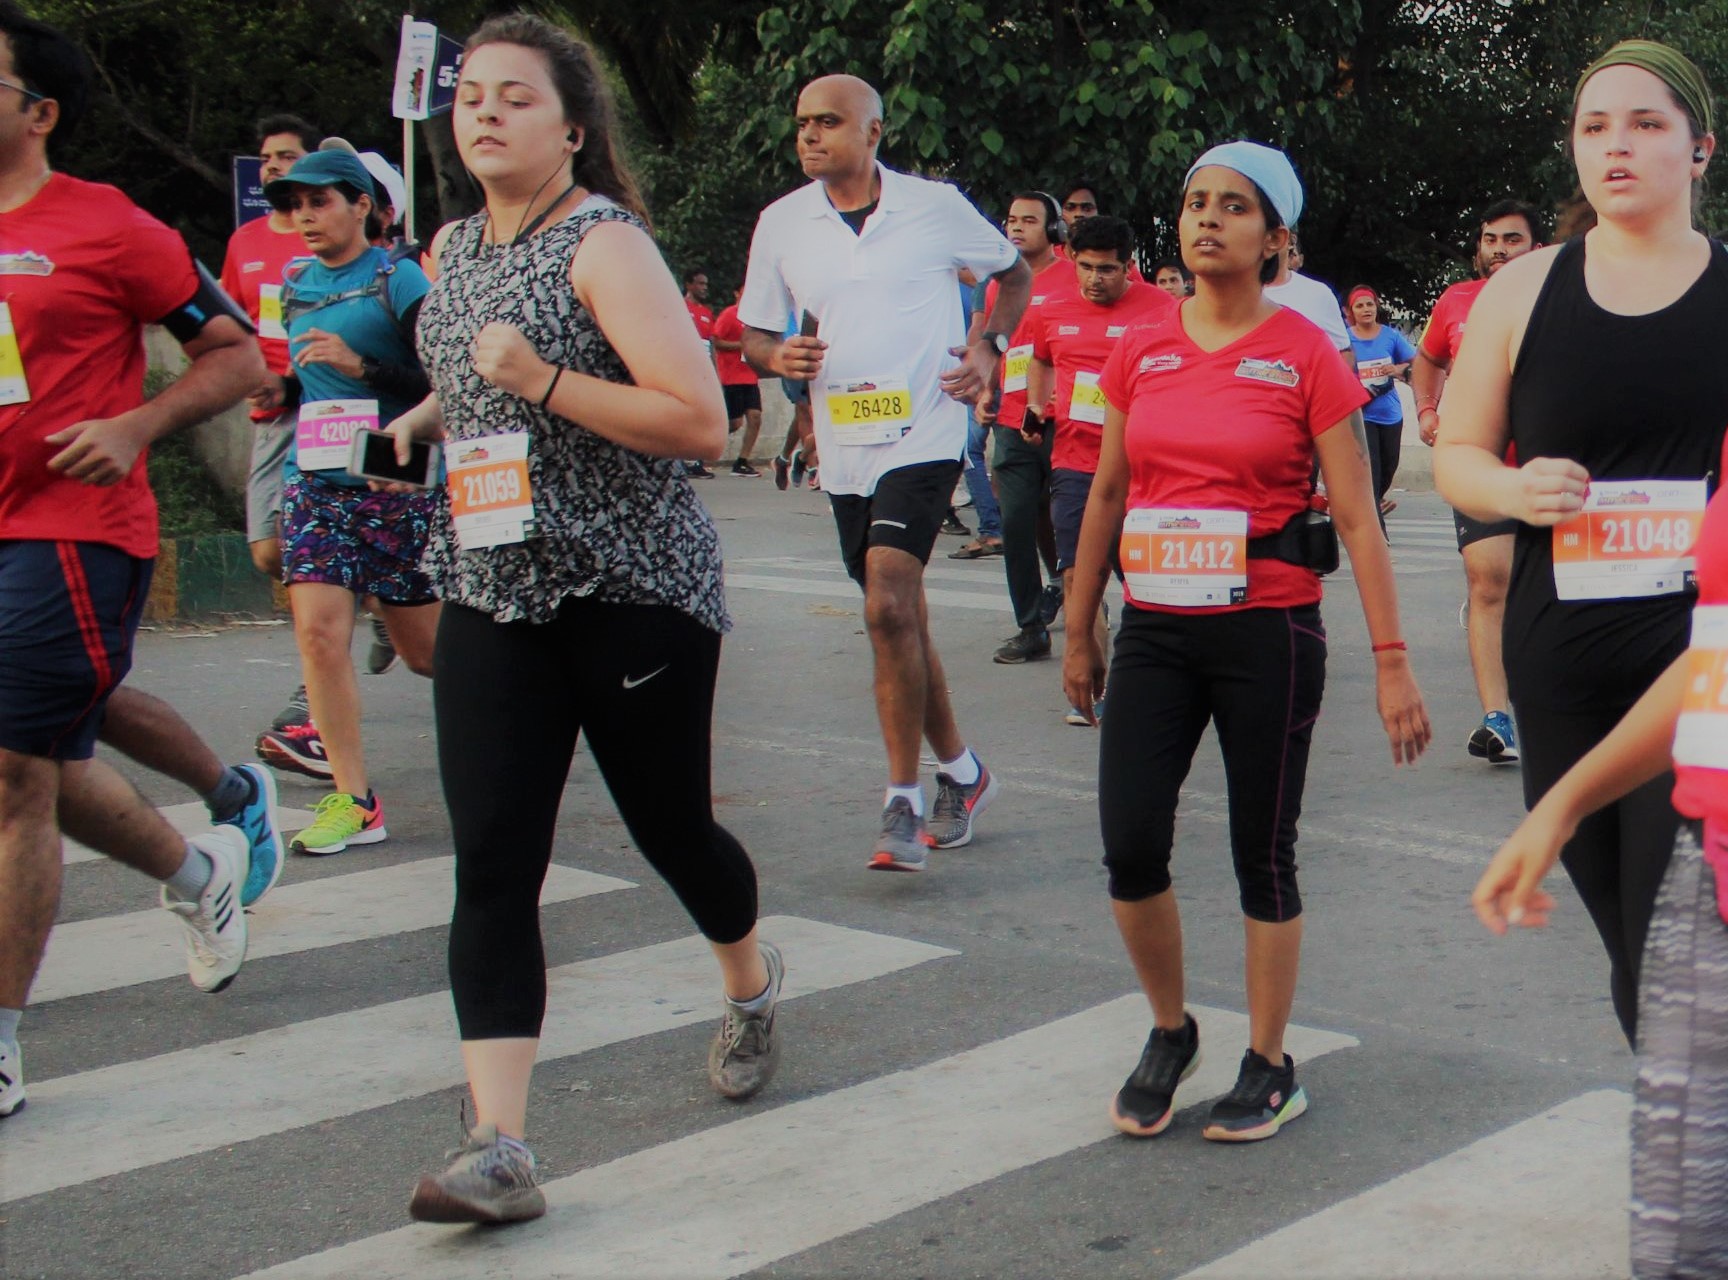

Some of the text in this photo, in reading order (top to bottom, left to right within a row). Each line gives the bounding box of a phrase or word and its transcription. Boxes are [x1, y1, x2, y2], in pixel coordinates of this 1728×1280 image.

[852, 396, 902, 418] 26428
[462, 467, 521, 507] 21059
[1563, 517, 1690, 553] HM 21048
[1128, 540, 1234, 569] HM 21412
